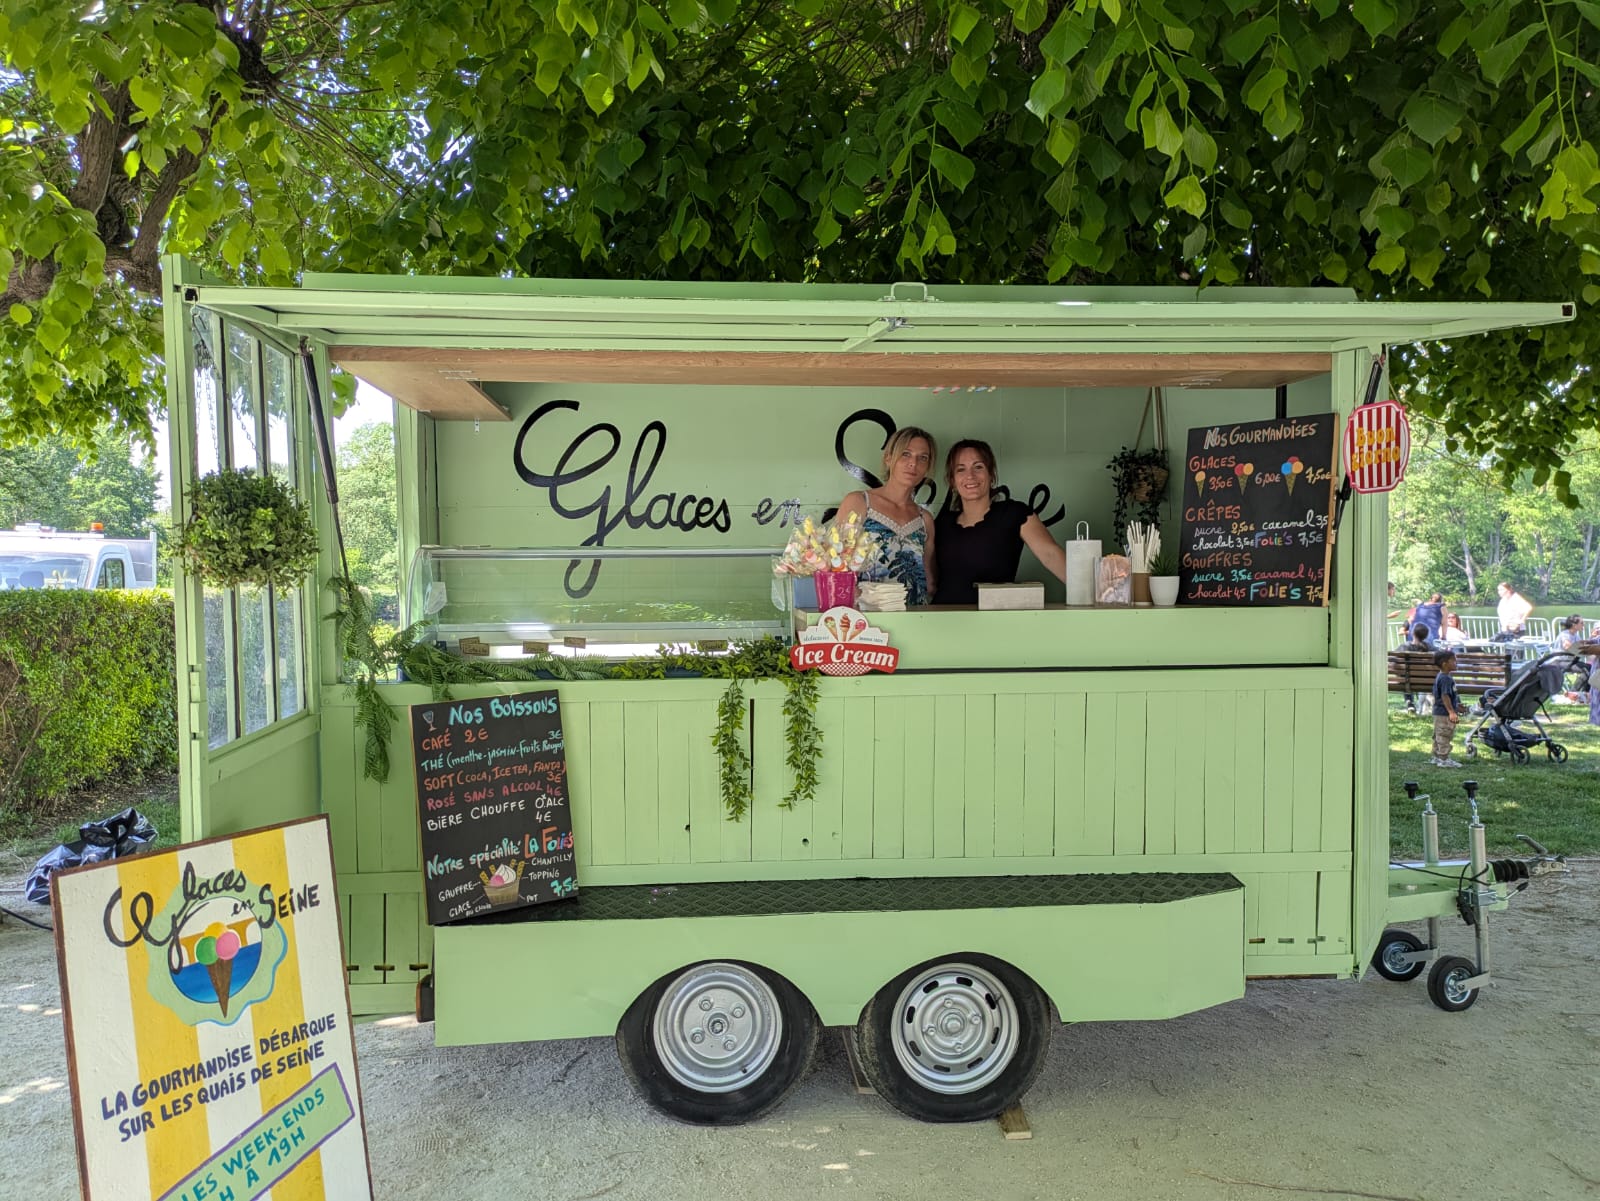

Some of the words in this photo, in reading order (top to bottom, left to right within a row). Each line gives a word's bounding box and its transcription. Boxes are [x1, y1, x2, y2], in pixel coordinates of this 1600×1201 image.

[1203, 427, 1228, 450] Nos
[1356, 427, 1396, 448] Buon
[1189, 455, 1237, 472] GLACES
[1351, 446, 1401, 472] giorno
[513, 399, 731, 599] Glaces
[751, 496, 806, 528] en
[1185, 498, 1241, 522] CRÊPES
[1194, 525, 1225, 538] sucre
[1262, 509, 1315, 530] caramel
[1192, 533, 1235, 551] chocolat
[1183, 551, 1253, 569] GAUFFRES
[1191, 569, 1225, 583] sucre
[1254, 563, 1305, 580] caramel
[1188, 583, 1233, 599] chocolat
[795, 645, 825, 666] Ice
[830, 643, 895, 668] Cream
[449, 704, 484, 726] Nos
[421, 727, 453, 751] CAFÉ
[548, 730, 563, 740] 3€
[421, 751, 443, 773] THÉ
[424, 771, 453, 792] SOFT
[427, 791, 456, 812] ROSÉ
[464, 787, 495, 804] SANS
[502, 781, 542, 796] ALCOOL
[546, 787, 563, 798] 4€
[470, 799, 526, 820] CHOUFFE
[535, 810, 552, 823] 4€
[531, 852, 573, 867] CHANTILLY
[438, 882, 475, 902] GAUFFRE
[231, 898, 254, 917] en
[101, 1090, 129, 1121] LA
[131, 1044, 253, 1108] GOURMANDISE
[259, 1013, 337, 1056] DÉBARQUE
[118, 1110, 156, 1143] SUR
[160, 1092, 194, 1122] LES
[196, 1071, 247, 1105] QUAIS
[251, 1061, 273, 1085] DE
[276, 1040, 325, 1075] SEINE
[221, 1087, 326, 1176] WEEK-ENDS
[267, 1126, 306, 1167] 19H
